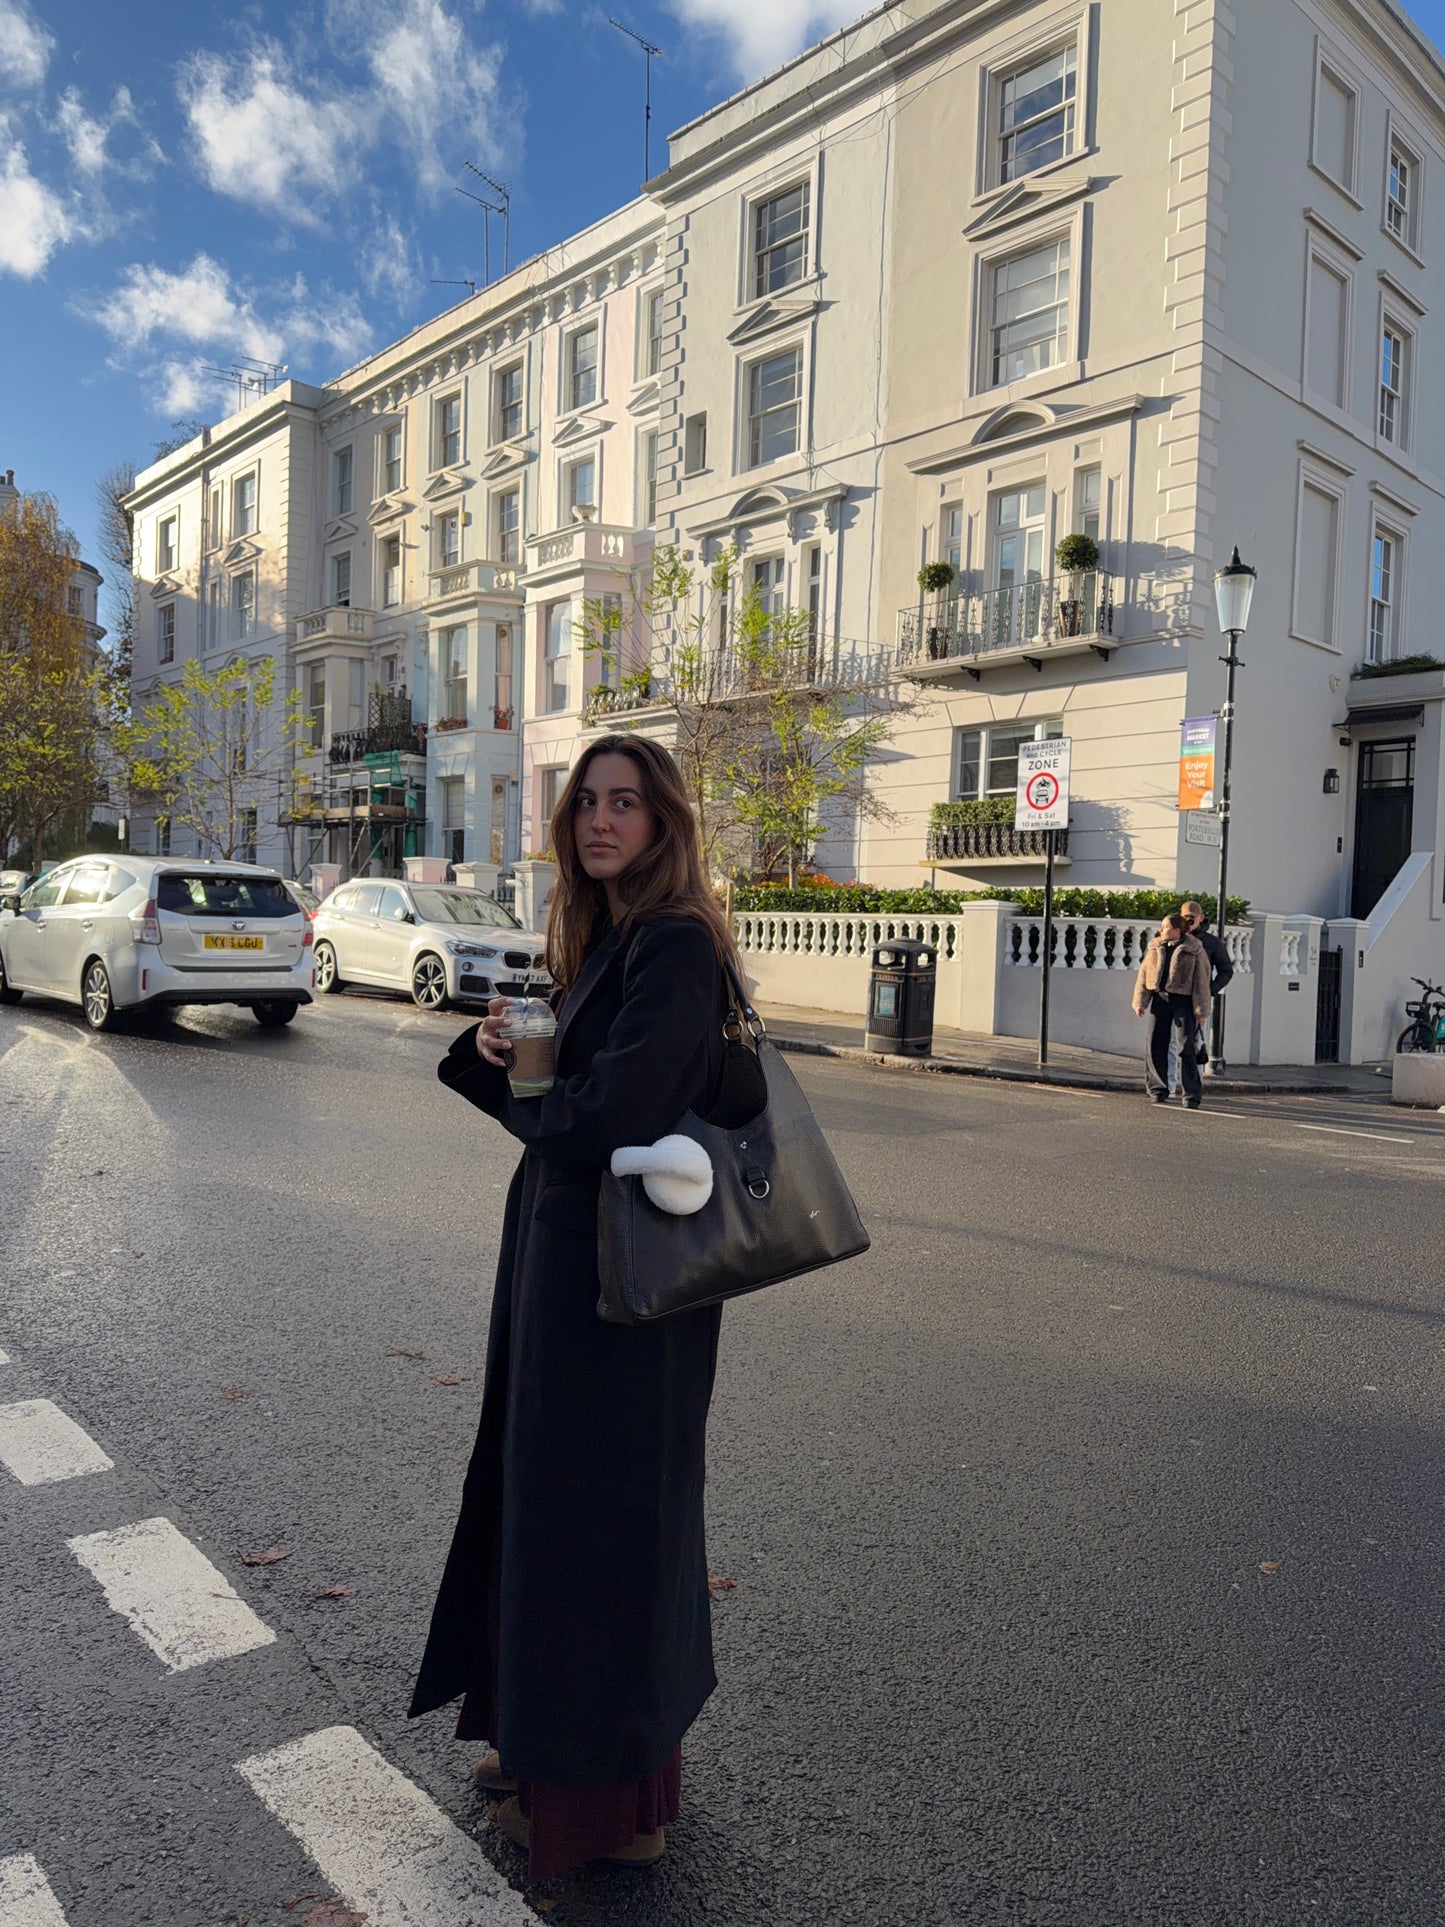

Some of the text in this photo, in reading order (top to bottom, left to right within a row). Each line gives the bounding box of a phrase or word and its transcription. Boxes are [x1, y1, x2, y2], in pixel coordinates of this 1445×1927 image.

[1022, 740, 1067, 752] PEDESTRIAN
[1026, 749, 1062, 759] and CYCLE
[1028, 758, 1059, 771] ZONE
[1185, 761, 1209, 771] Enjoy
[1187, 771, 1207, 779] Your
[1027, 812, 1036, 820] Fri
